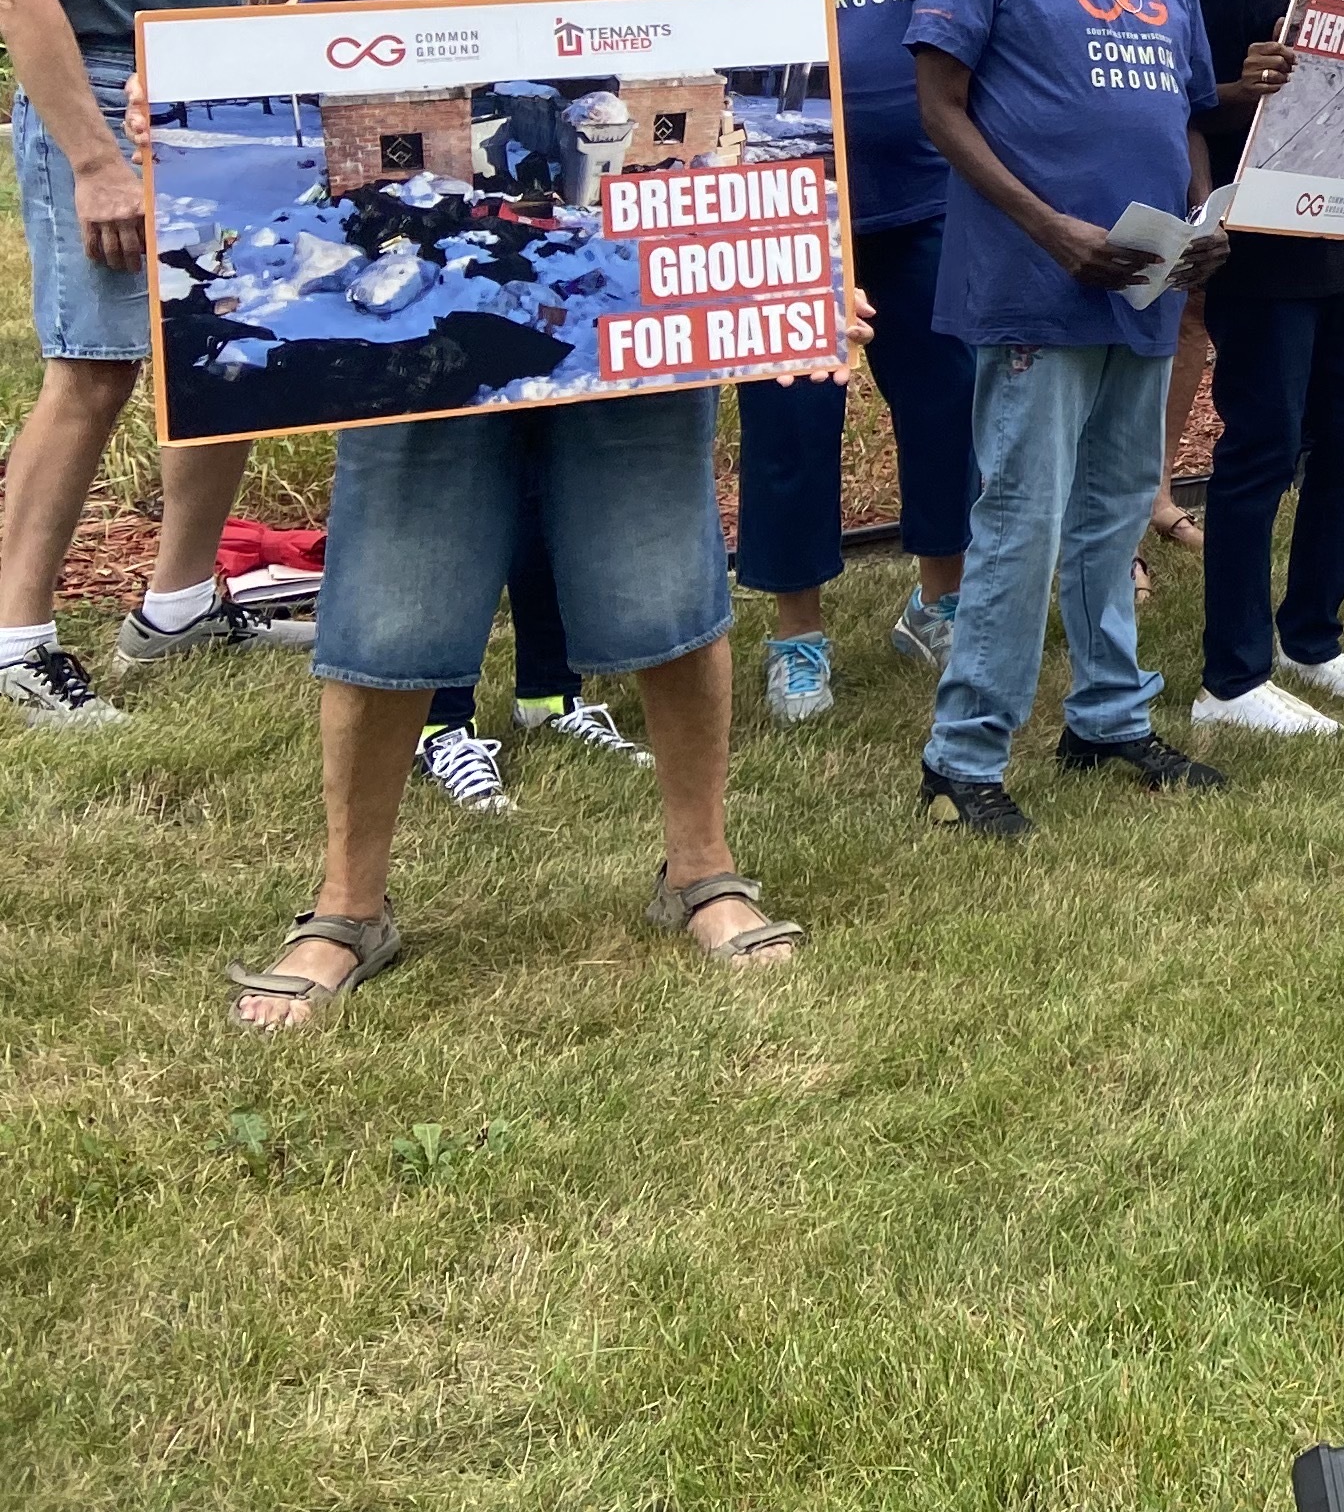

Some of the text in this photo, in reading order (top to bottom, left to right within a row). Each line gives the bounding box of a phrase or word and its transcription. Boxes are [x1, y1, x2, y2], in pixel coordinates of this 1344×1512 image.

[415, 30, 479, 44] COMMON
[585, 24, 672, 41] TENANTS
[416, 43, 480, 58] GROUND
[590, 37, 652, 52] UNITED
[1087, 40, 1175, 70] COMMON
[609, 166, 819, 233] BREEDING
[648, 233, 823, 298] GROUND
[608, 299, 828, 373] FOR RATS!
